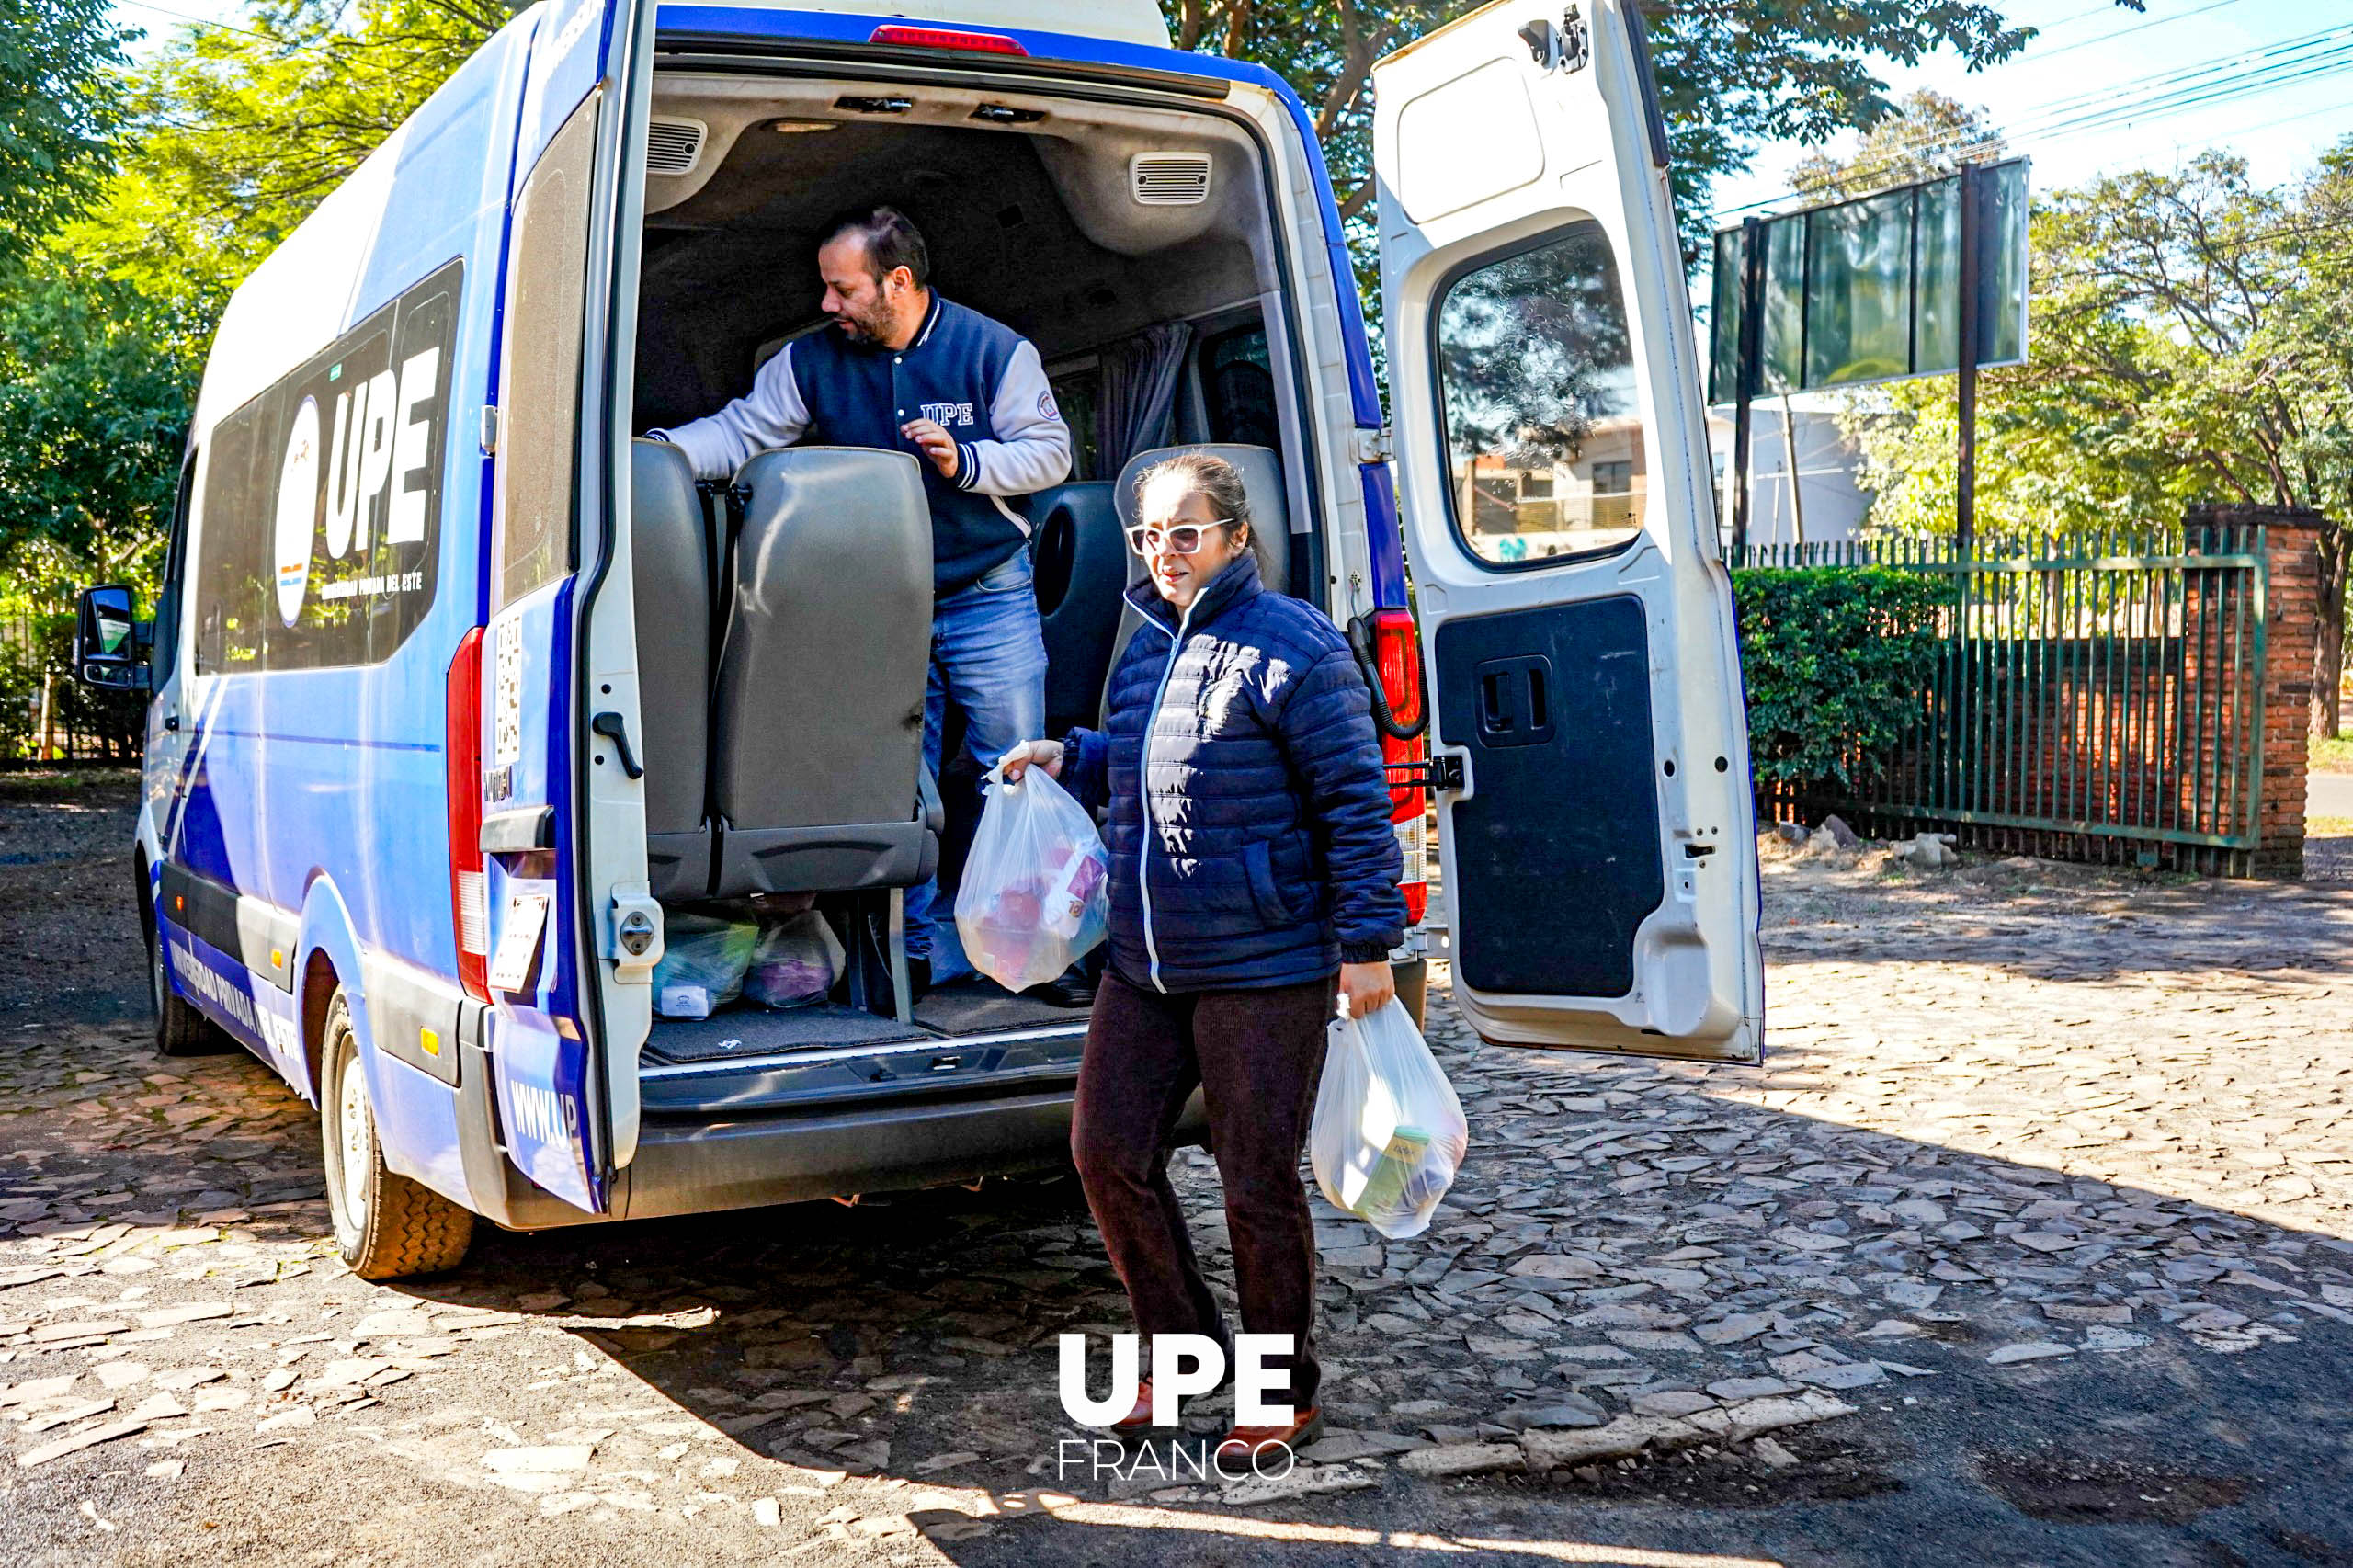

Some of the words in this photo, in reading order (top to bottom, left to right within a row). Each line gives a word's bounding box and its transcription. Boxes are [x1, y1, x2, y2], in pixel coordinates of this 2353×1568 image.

[920, 403, 974, 426] UPE
[325, 346, 439, 560] UPE
[386, 574, 400, 593] DEL
[402, 571, 423, 591] ESTE
[215, 972, 256, 1034] PRIVADA
